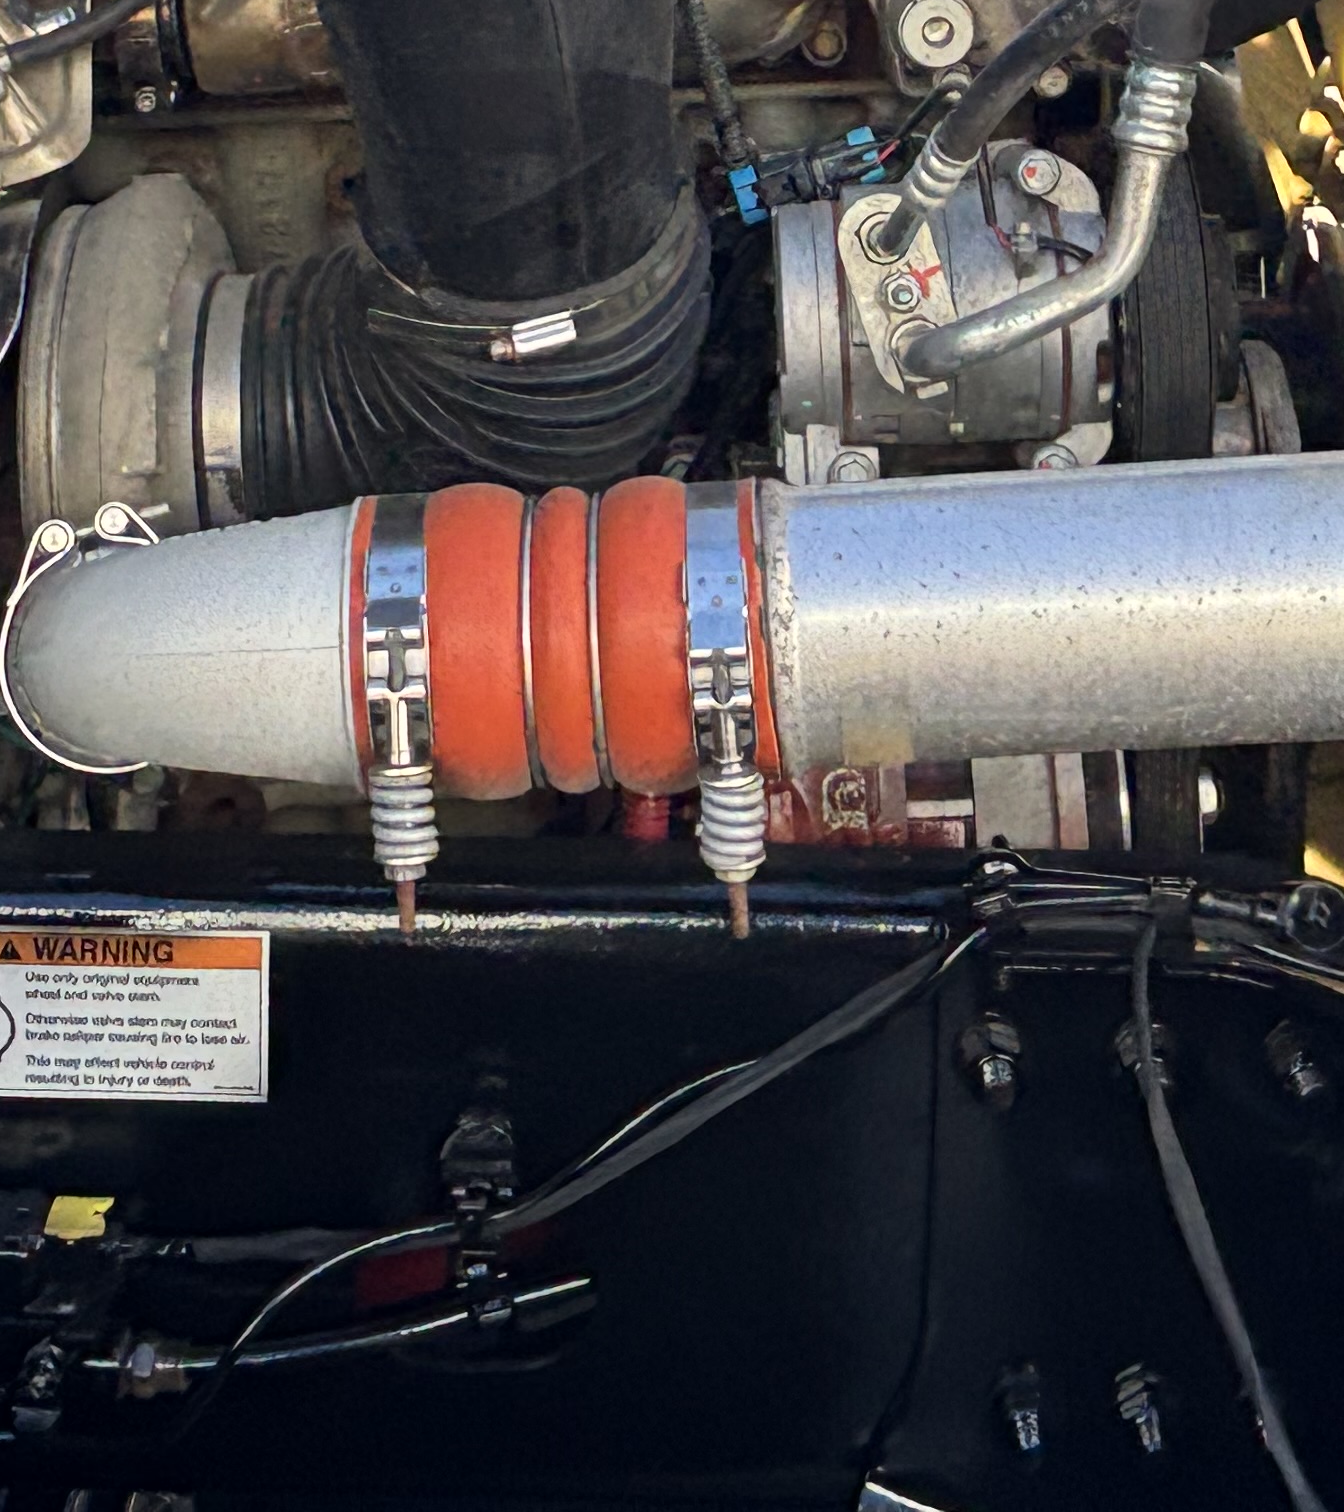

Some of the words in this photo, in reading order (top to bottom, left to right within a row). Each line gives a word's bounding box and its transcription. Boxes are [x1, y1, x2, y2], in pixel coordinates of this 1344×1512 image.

[33, 937, 174, 964] WARNING
[53, 972, 79, 986] only
[83, 973, 130, 987] original
[134, 975, 199, 989] equipment
[64, 990, 87, 1000] and
[25, 1012, 88, 1025] Otherwise
[128, 1015, 158, 1027] stem
[161, 1018, 187, 1029] may
[191, 1018, 237, 1029] contact
[186, 1034, 197, 1044] to
[25, 1054, 51, 1067] This
[54, 1056, 81, 1069] may
[124, 1057, 167, 1070] vehicle
[99, 1075, 133, 1087] injury
